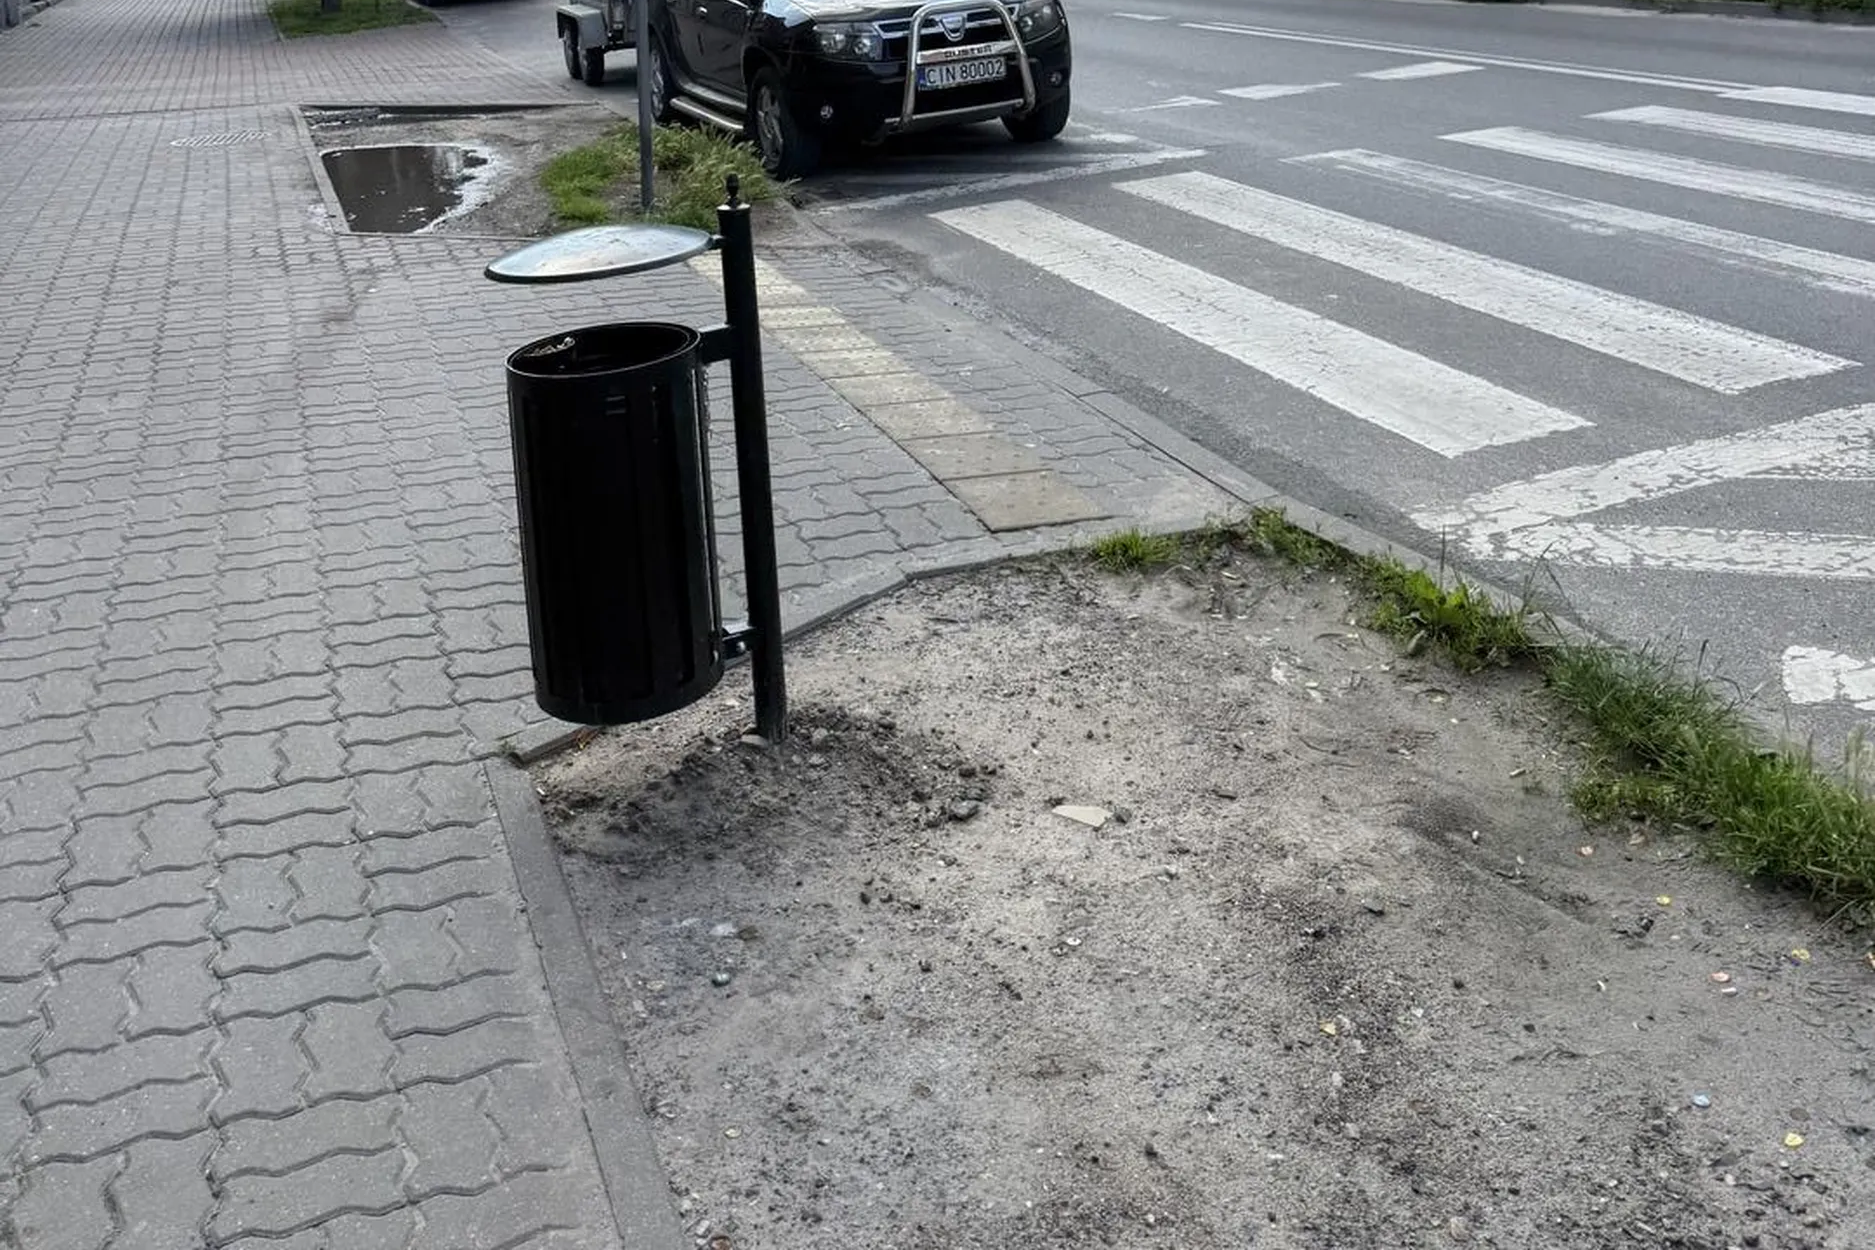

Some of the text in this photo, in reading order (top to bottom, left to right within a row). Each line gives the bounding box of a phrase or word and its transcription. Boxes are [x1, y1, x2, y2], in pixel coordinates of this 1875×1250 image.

[944, 45, 992, 58] DUSTER
[926, 59, 1003, 84] CIN 80002
